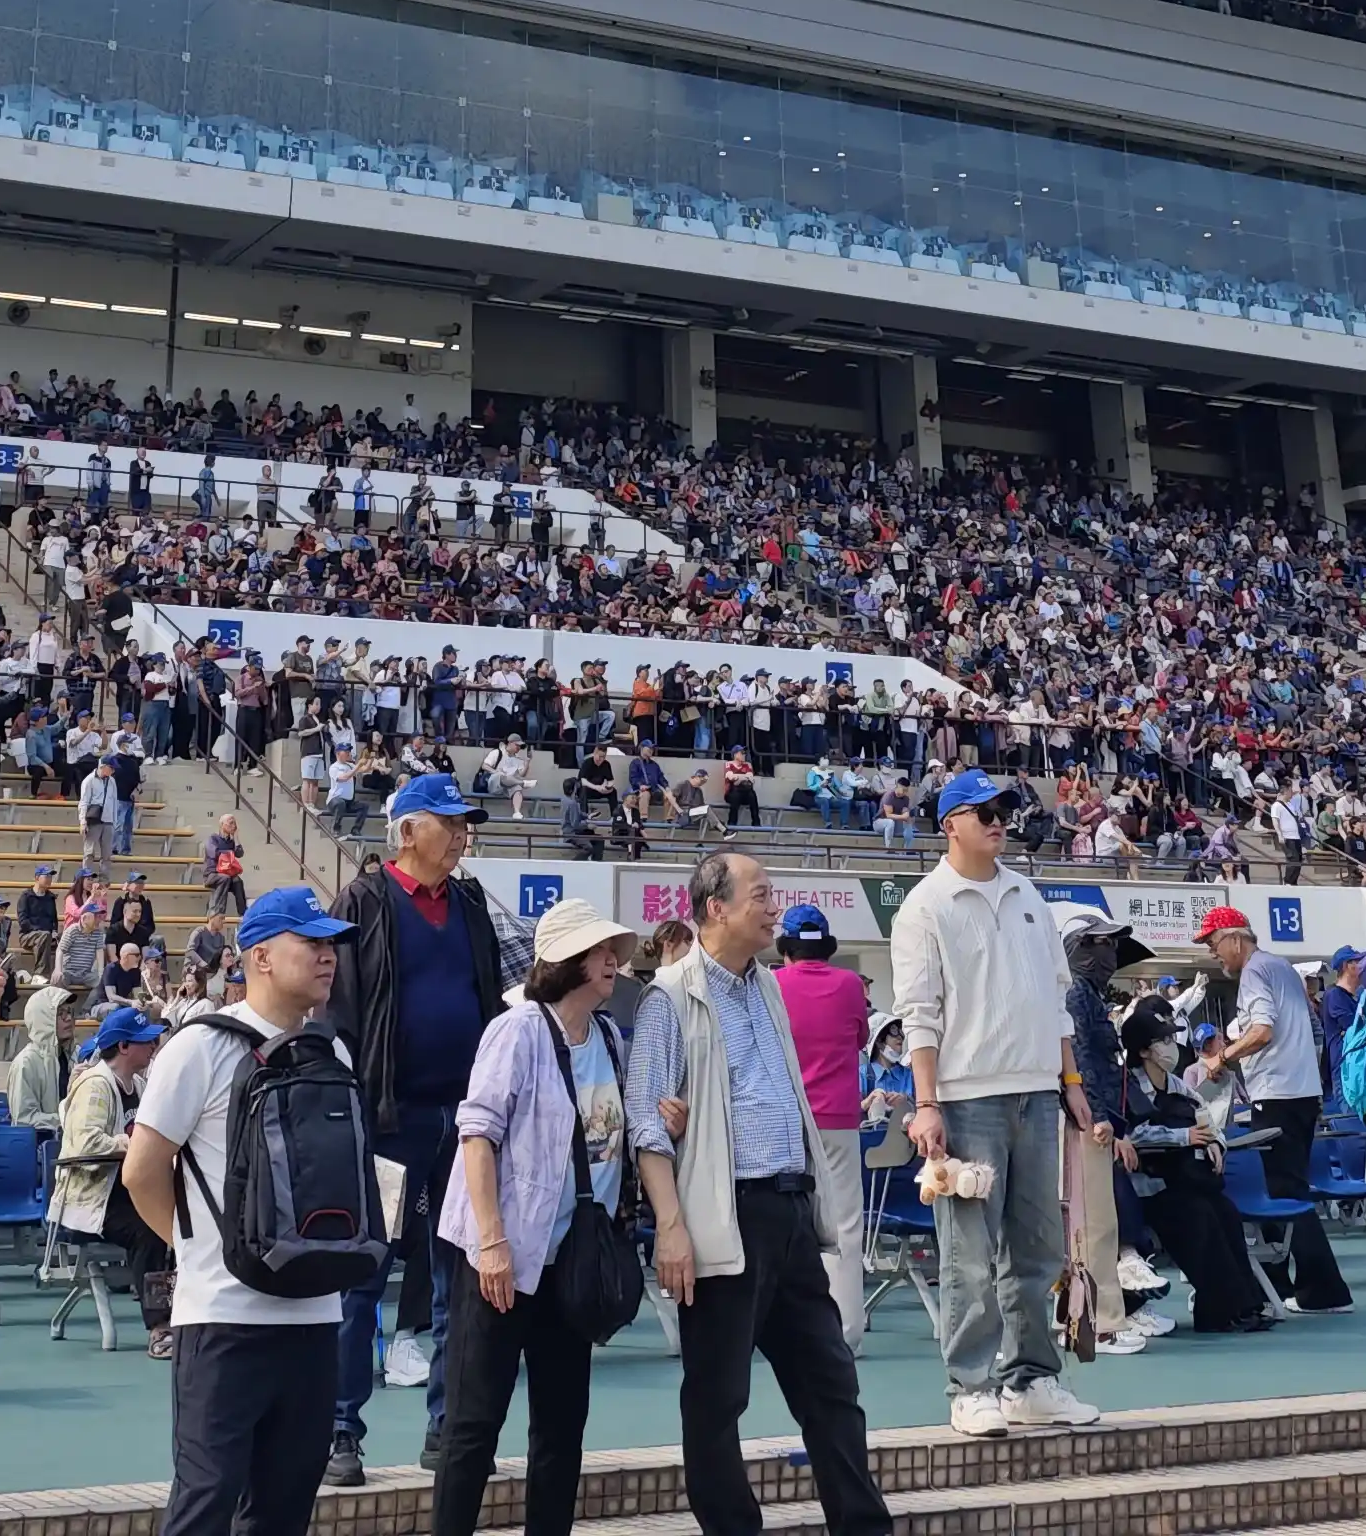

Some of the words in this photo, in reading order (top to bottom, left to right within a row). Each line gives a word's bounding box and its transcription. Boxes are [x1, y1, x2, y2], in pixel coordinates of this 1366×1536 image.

[210, 628, 240, 650] 2-3
[524, 886, 559, 913] 1-3
[774, 890, 854, 908] THEATRE
[1129, 898, 1186, 917] 網上訂座
[1272, 907, 1301, 932] 1-3
